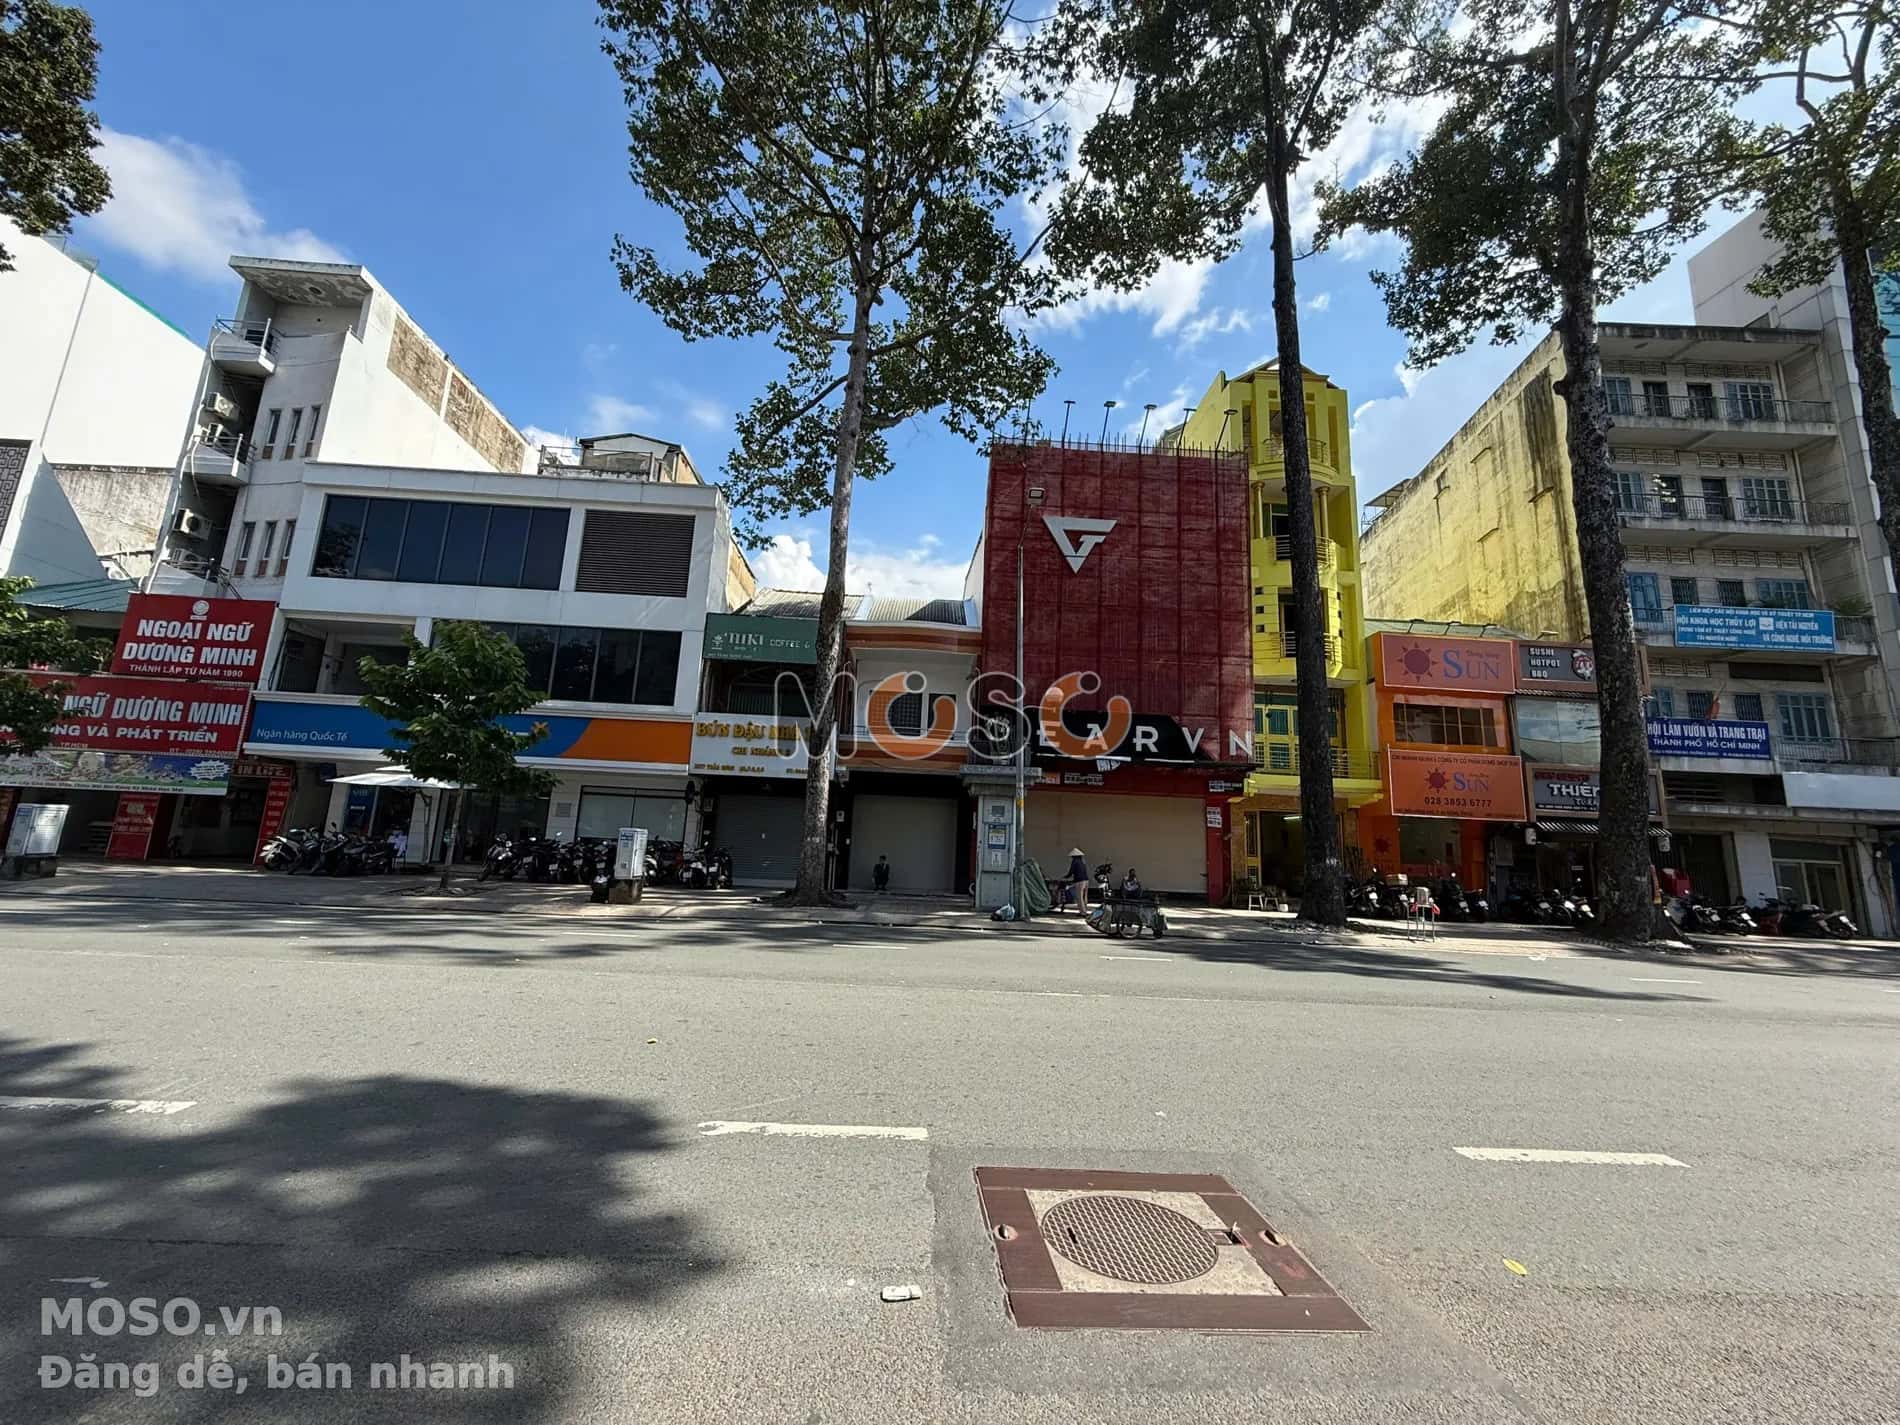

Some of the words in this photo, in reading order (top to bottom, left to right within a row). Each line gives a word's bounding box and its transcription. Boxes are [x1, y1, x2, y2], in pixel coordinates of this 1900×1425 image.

[137, 619, 202, 642] NGOẠI
[206, 622, 254, 642] NGỮ
[122, 642, 195, 663] DƯƠNG
[200, 647, 257, 666] MINH
[1529, 647, 1555, 656] SUSHI
[130, 664, 161, 673] THÀNH
[1443, 649, 1499, 680] SUN
[111, 696, 184, 722] DƯƠNG
[187, 701, 243, 726] MINH
[87, 723, 109, 737] VÀ
[115, 726, 163, 739] PHÁT
[167, 726, 218, 743] TRIỂN
[1718, 727, 1745, 739] TRANG
[1746, 727, 1766, 742] TRẠI
[1738, 742, 1760, 750] MINH
